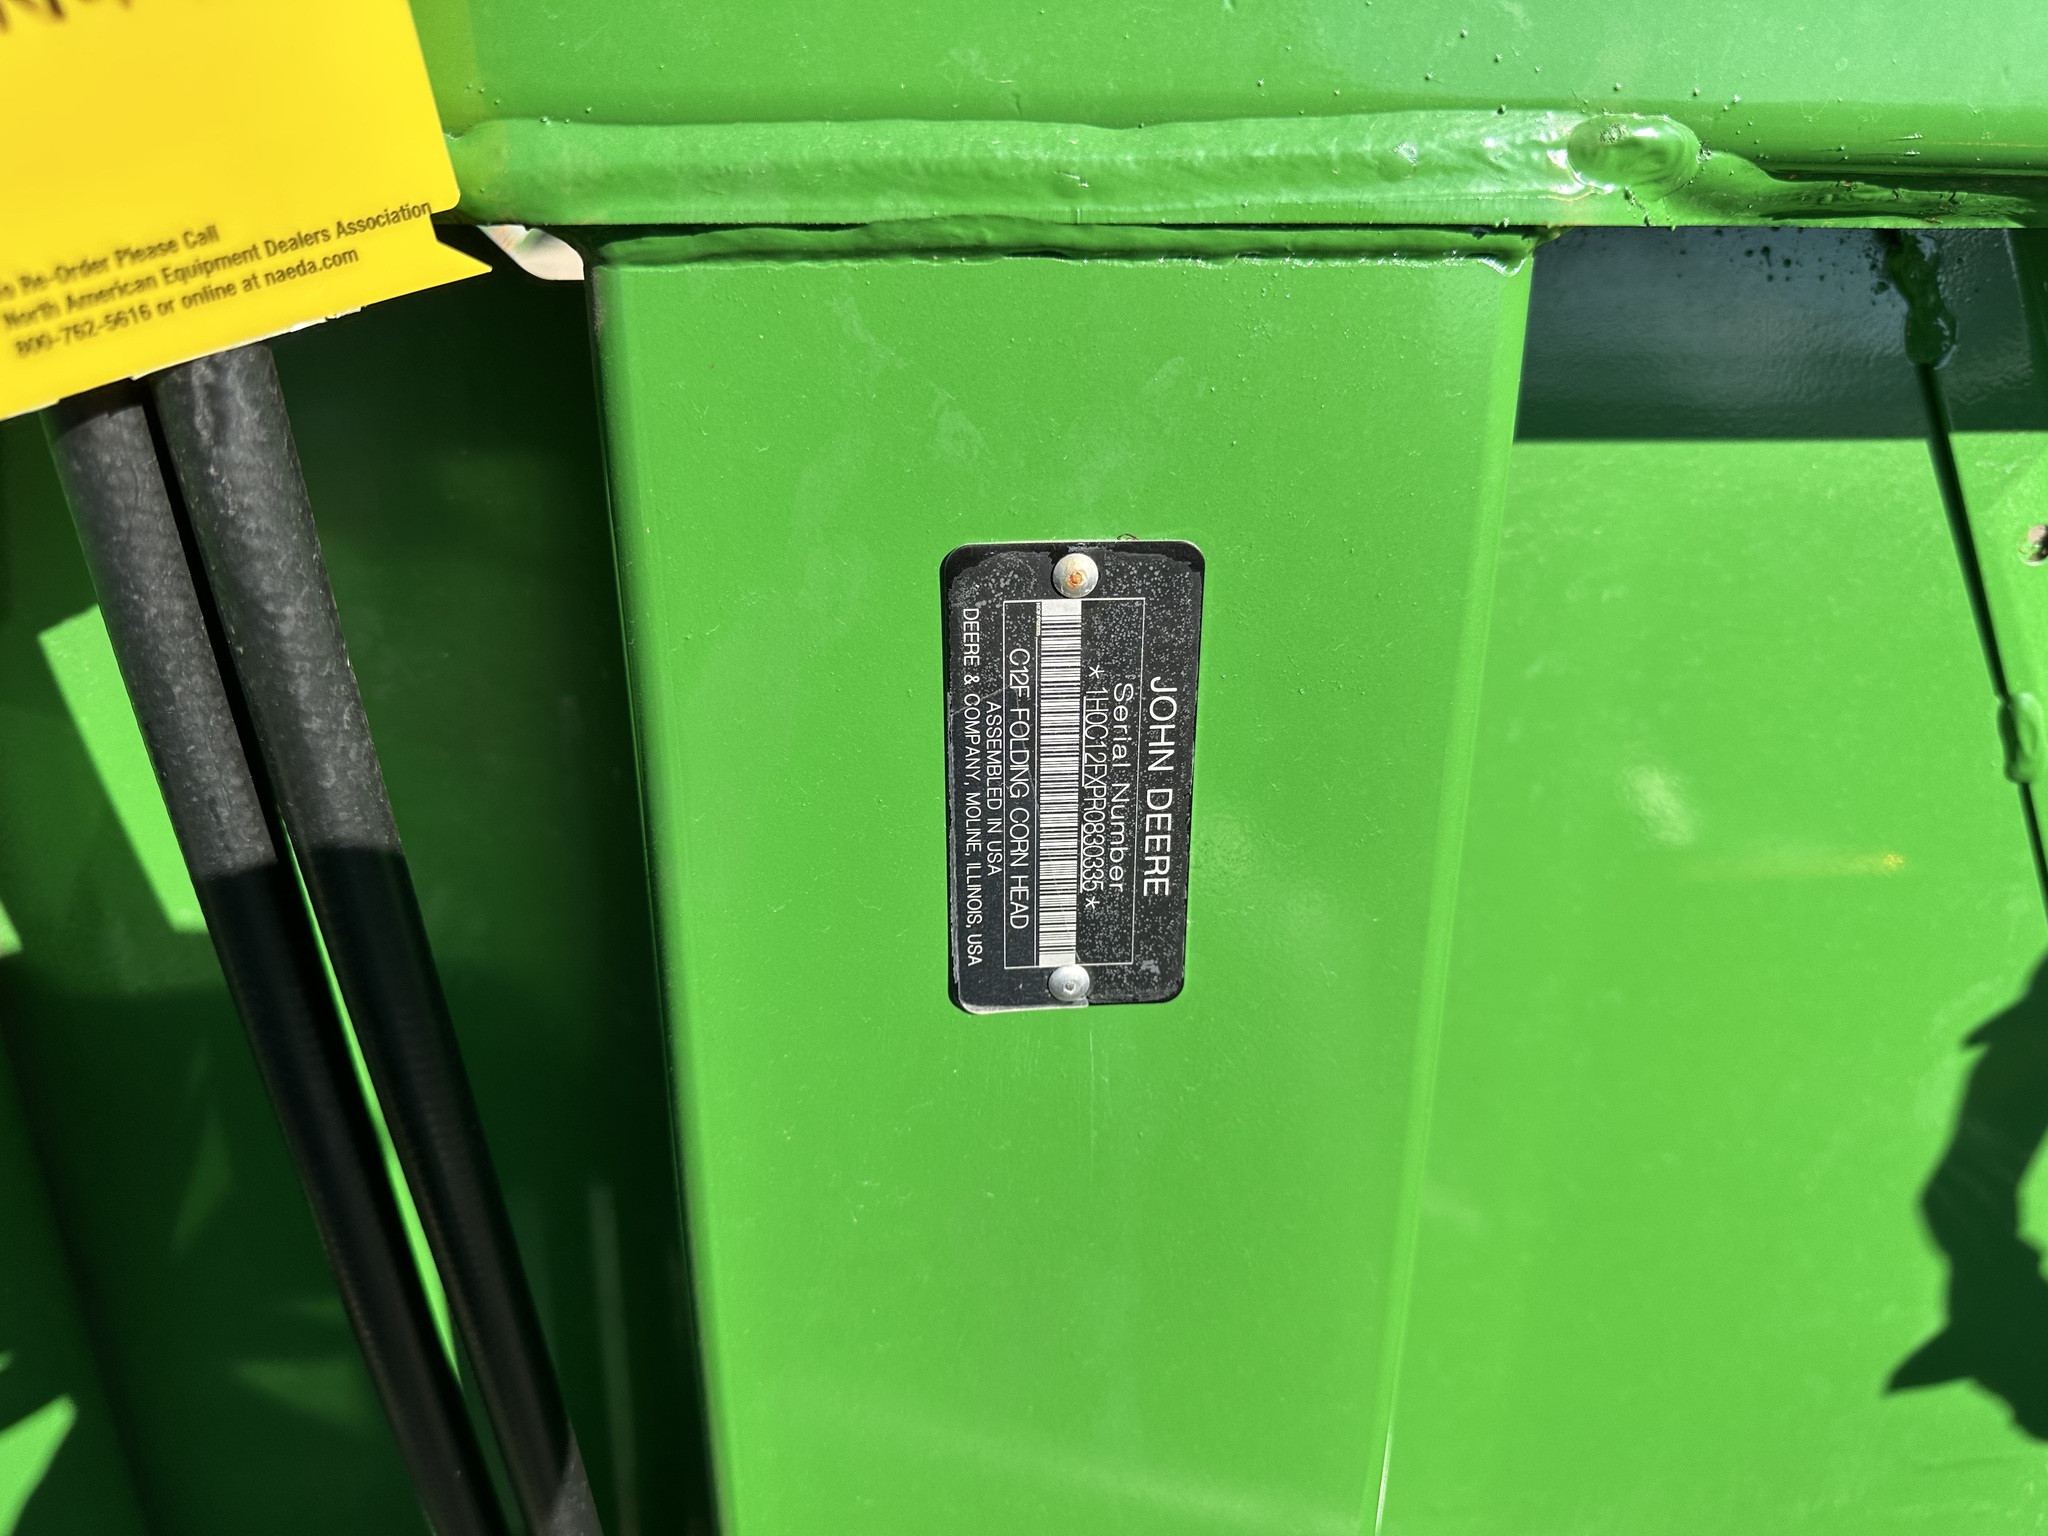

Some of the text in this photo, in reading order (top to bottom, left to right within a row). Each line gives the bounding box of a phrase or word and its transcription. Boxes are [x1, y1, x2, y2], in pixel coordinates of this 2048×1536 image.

[3, 201, 432, 327] North American Equipment Dealers Association
[114, 238, 179, 268] Please
[182, 225, 220, 249] Call
[156, 299, 176, 316] or
[181, 282, 238, 310] online
[241, 273, 262, 293] at
[263, 248, 360, 287] naeda.com
[963, 608, 984, 967] DEERE & COMPANY, MOLINE, ILLINOIS, USA
[986, 700, 1004, 876] ASSEMBLED IN USA
[1009, 648, 1031, 930] C12F FOLDING CORN HEAD
[1081, 688, 1109, 892] 1H0C12FXPR0830335
[1108, 682, 1134, 893] Serial Number
[1143, 676, 1178, 897] JOHN DEERE
